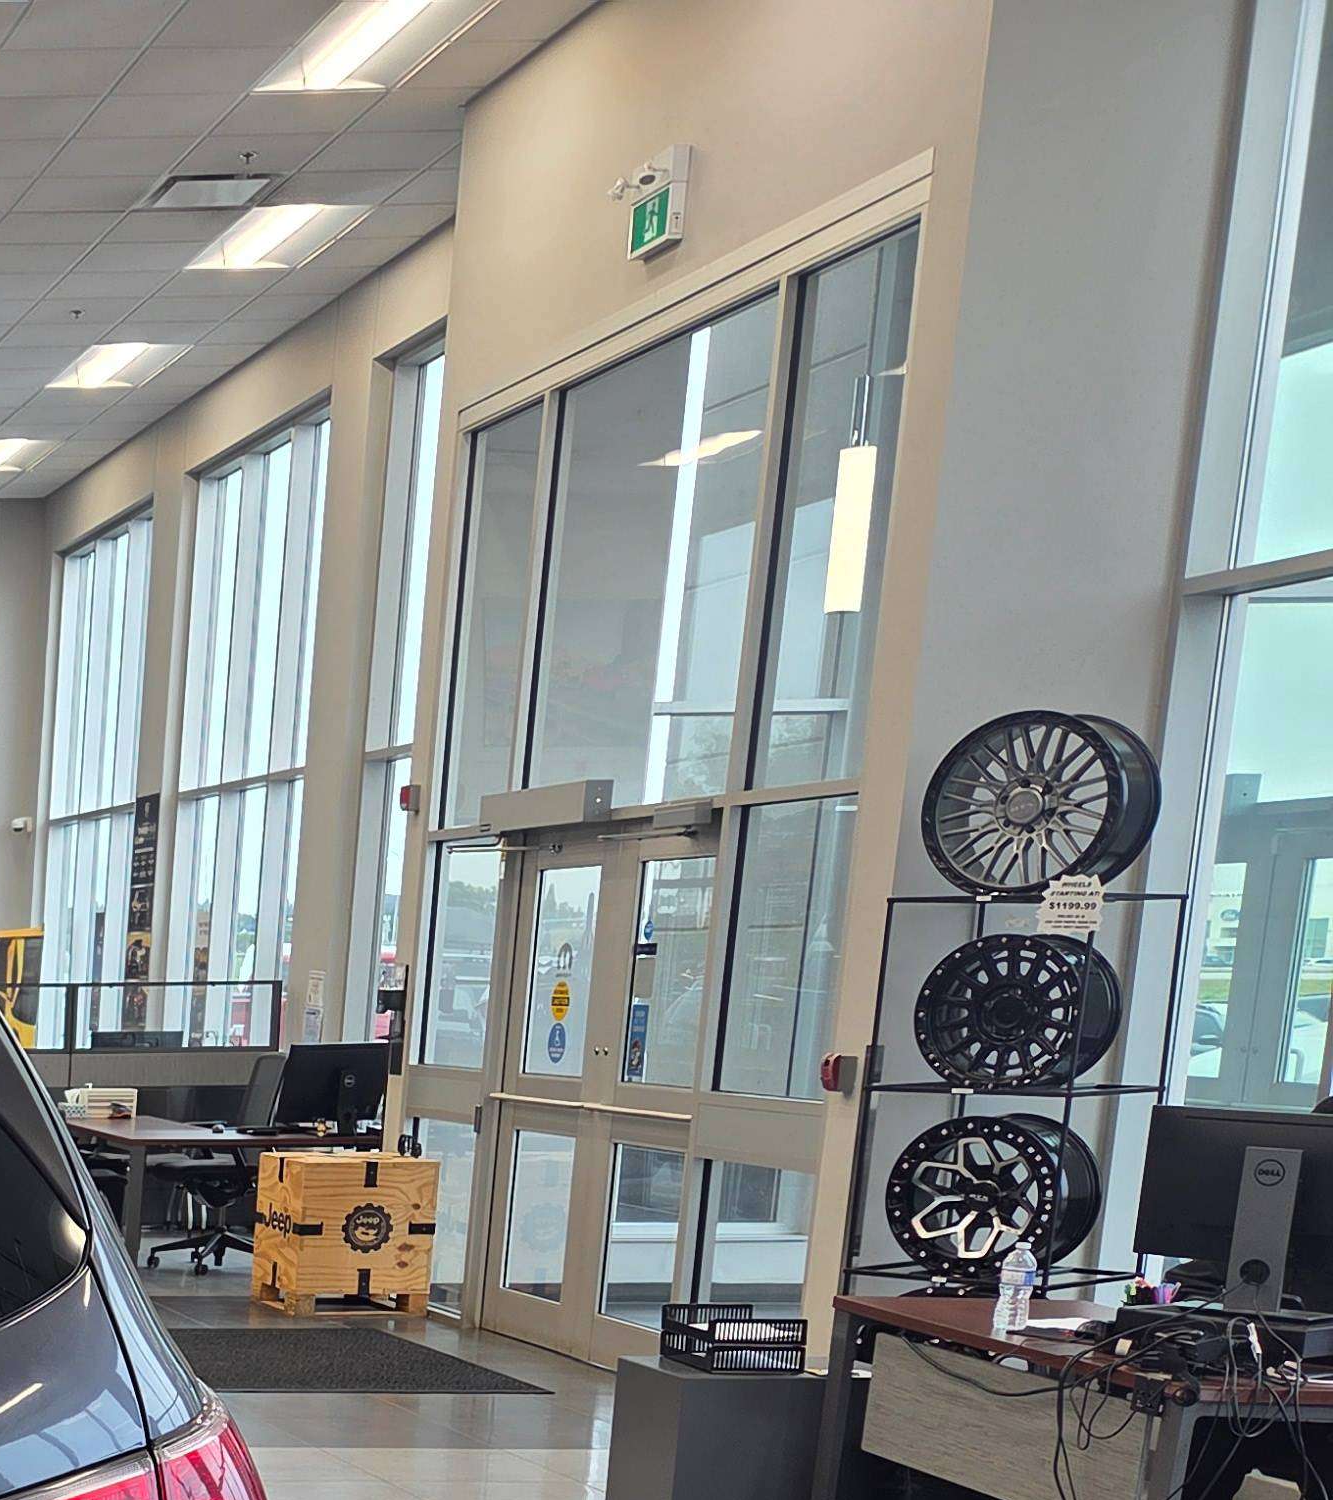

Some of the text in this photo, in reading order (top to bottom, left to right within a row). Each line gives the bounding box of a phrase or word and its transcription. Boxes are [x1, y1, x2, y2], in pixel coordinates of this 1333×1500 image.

[1048, 902, 1098, 910] $1199.99
[264, 1202, 292, 1239] Jeep
[355, 1214, 380, 1225] Jeep
